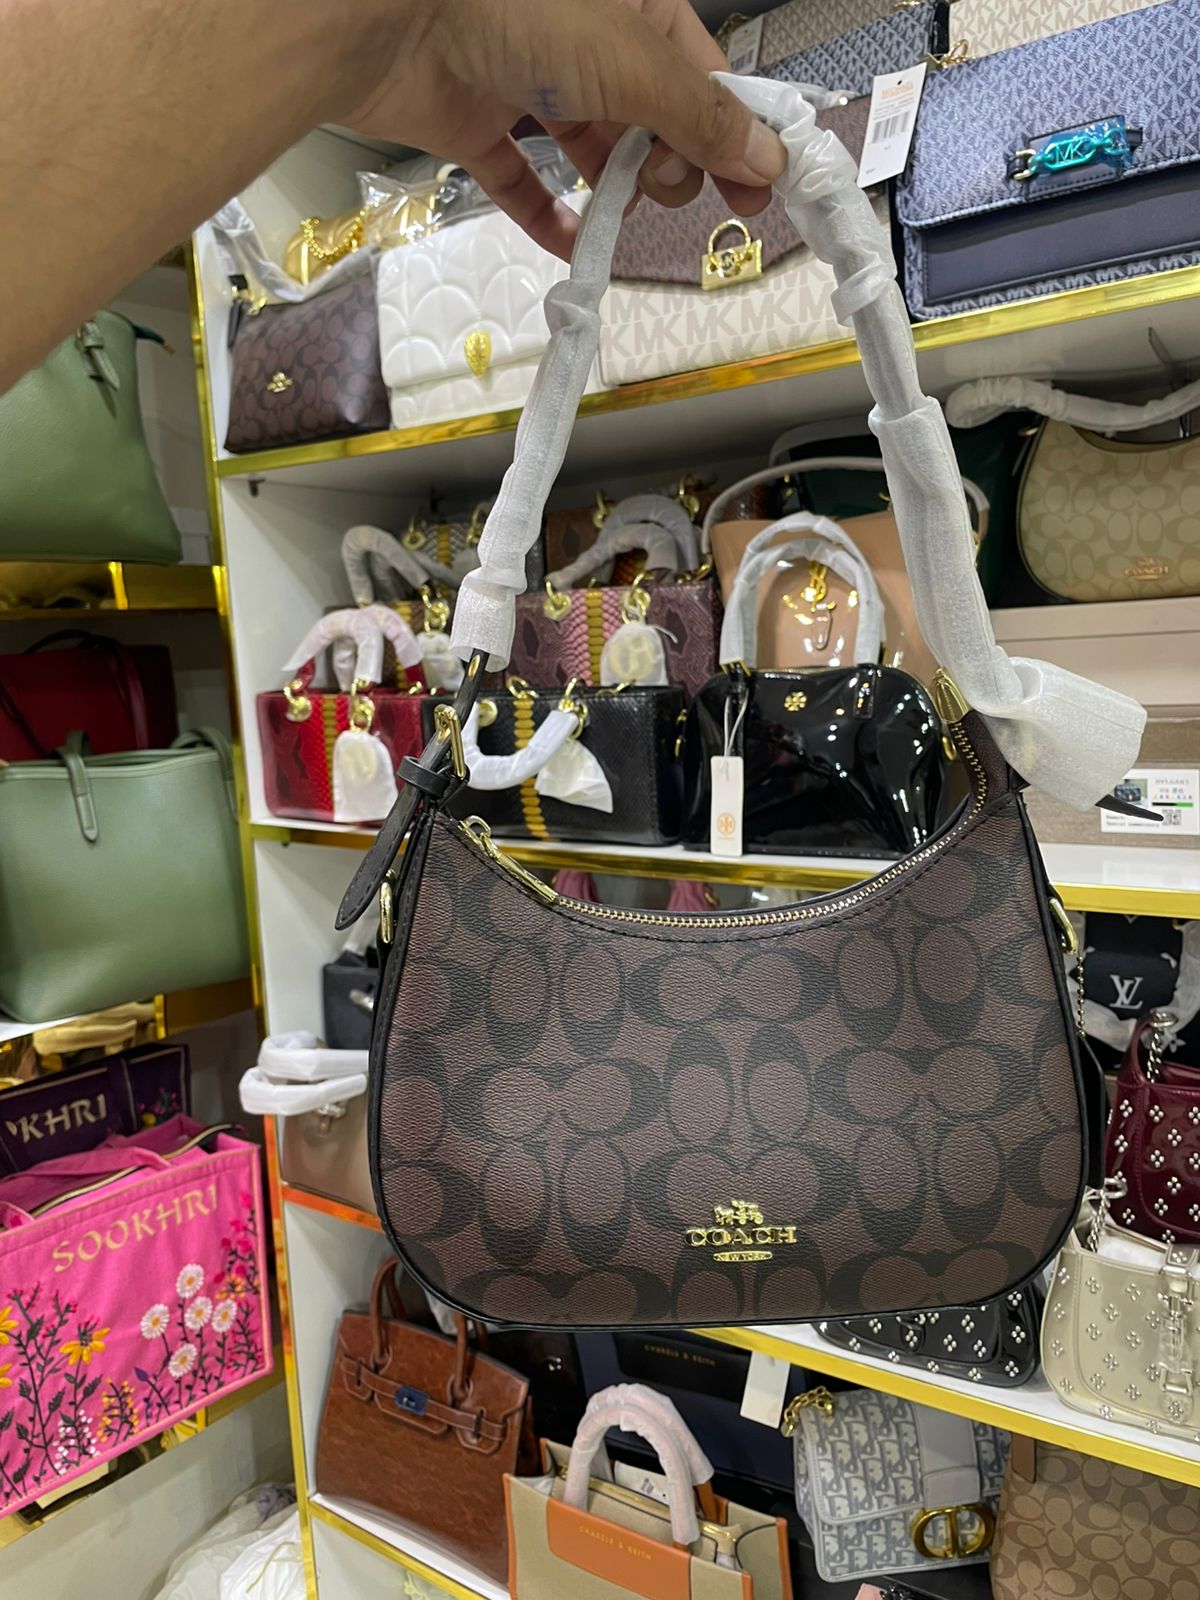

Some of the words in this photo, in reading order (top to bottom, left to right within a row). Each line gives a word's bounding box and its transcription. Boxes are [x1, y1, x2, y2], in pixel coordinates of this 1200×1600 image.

[1109, 974, 1144, 1010] LV
[52, 1183, 218, 1274] SOOKHRI
[684, 1226, 798, 1247] COACH
